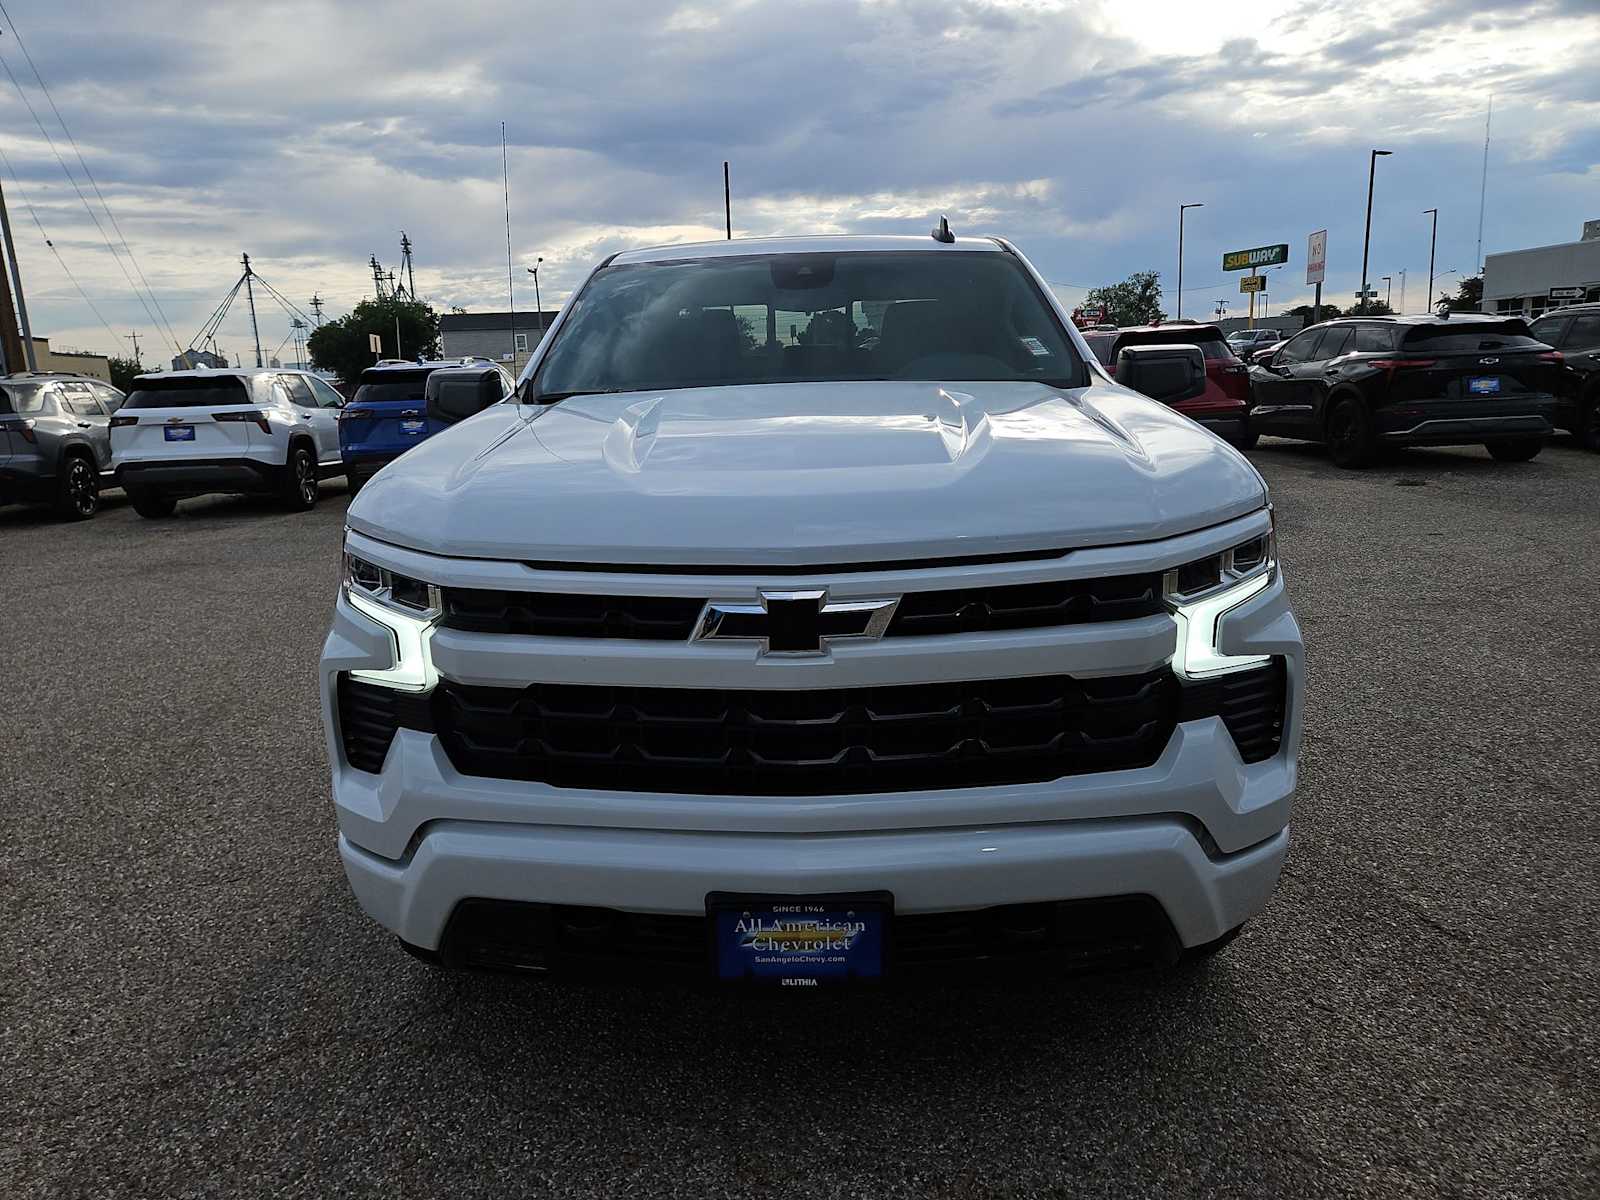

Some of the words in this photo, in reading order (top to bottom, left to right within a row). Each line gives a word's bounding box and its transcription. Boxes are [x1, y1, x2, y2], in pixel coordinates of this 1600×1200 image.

[1225, 247, 1279, 267] SUBWAY
[772, 905, 801, 913] SINCE
[735, 918, 762, 932] All
[770, 918, 866, 932] American
[752, 936, 853, 952] Chevrolet
[755, 956, 846, 964] SanAngeloChevy.com
[789, 978, 818, 986] LITHIA
